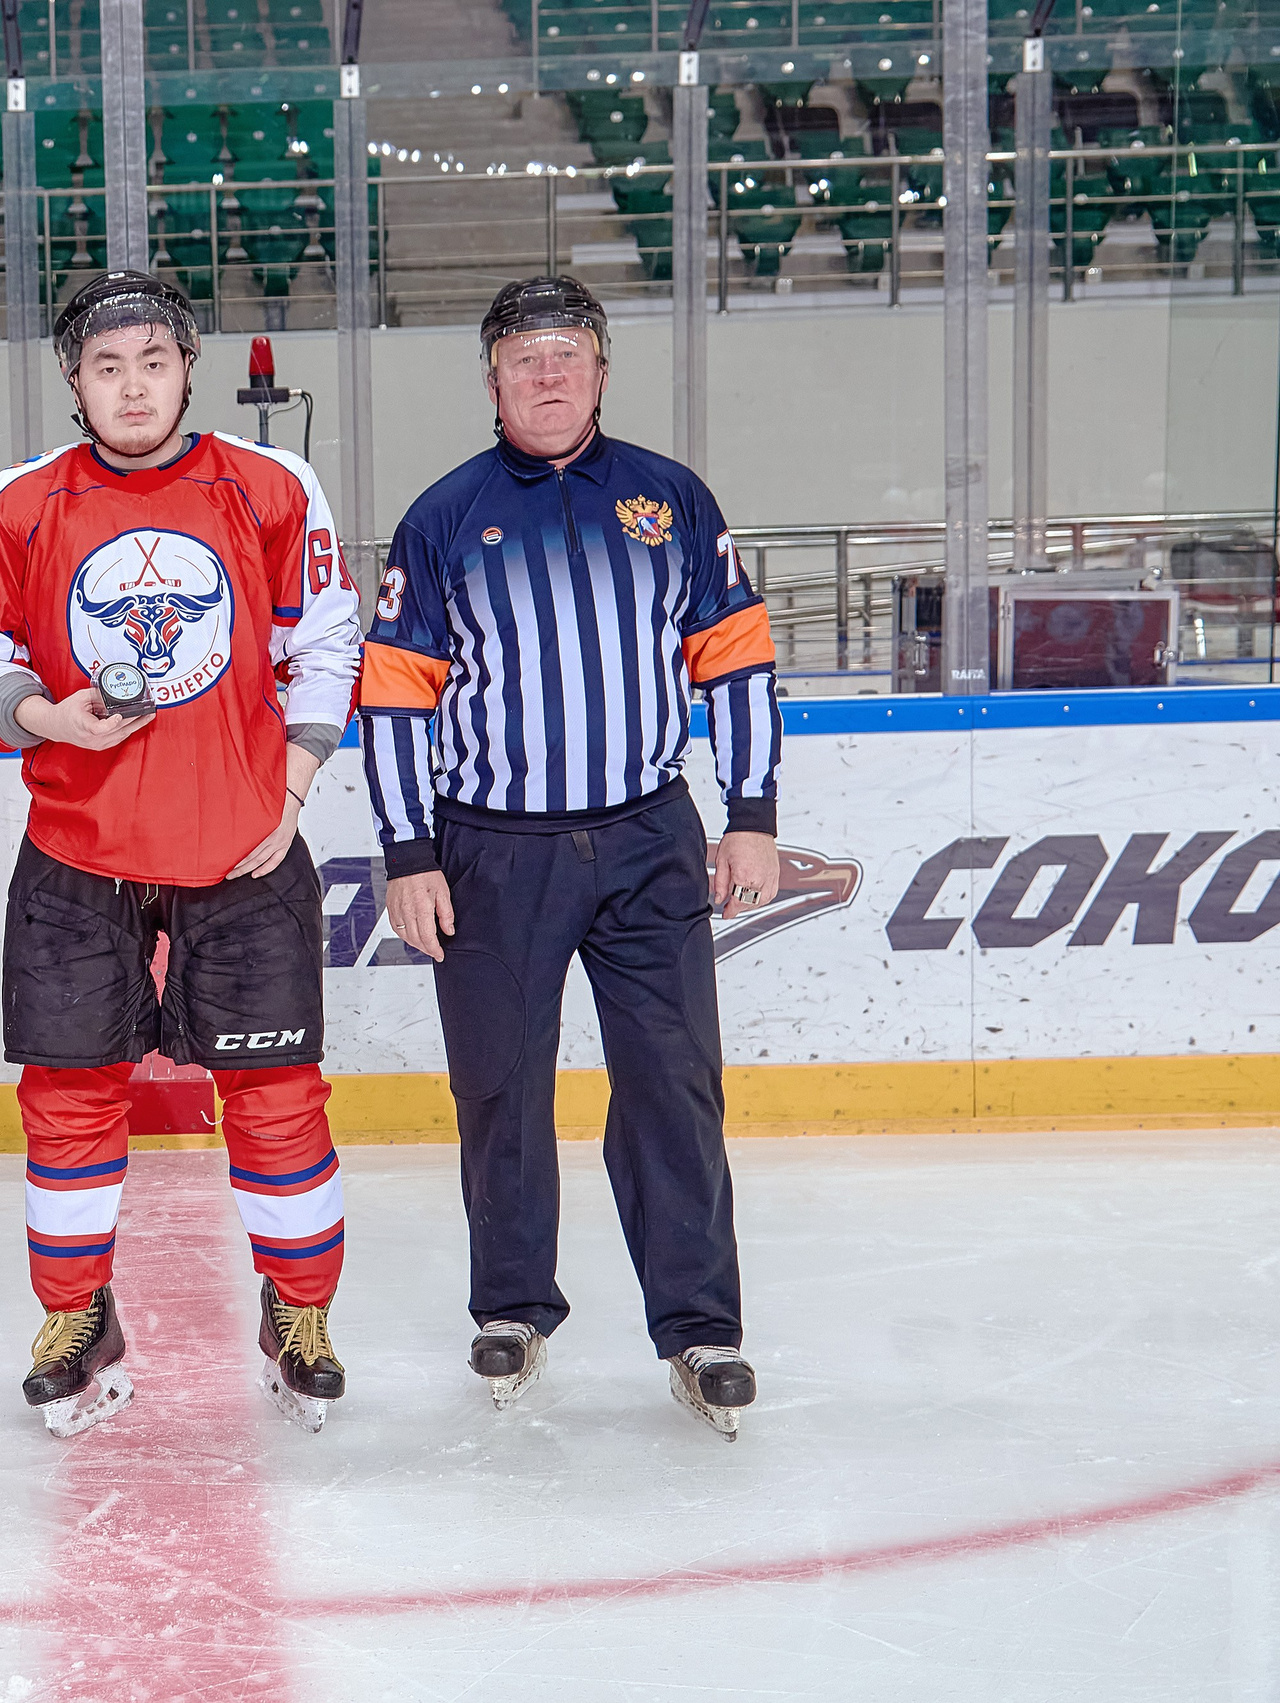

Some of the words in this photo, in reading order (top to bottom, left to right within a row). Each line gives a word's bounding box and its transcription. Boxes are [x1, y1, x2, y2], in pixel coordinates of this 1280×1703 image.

[717, 528, 747, 590] 7
[376, 566, 407, 622] 3
[214, 1028, 306, 1050] CCM
